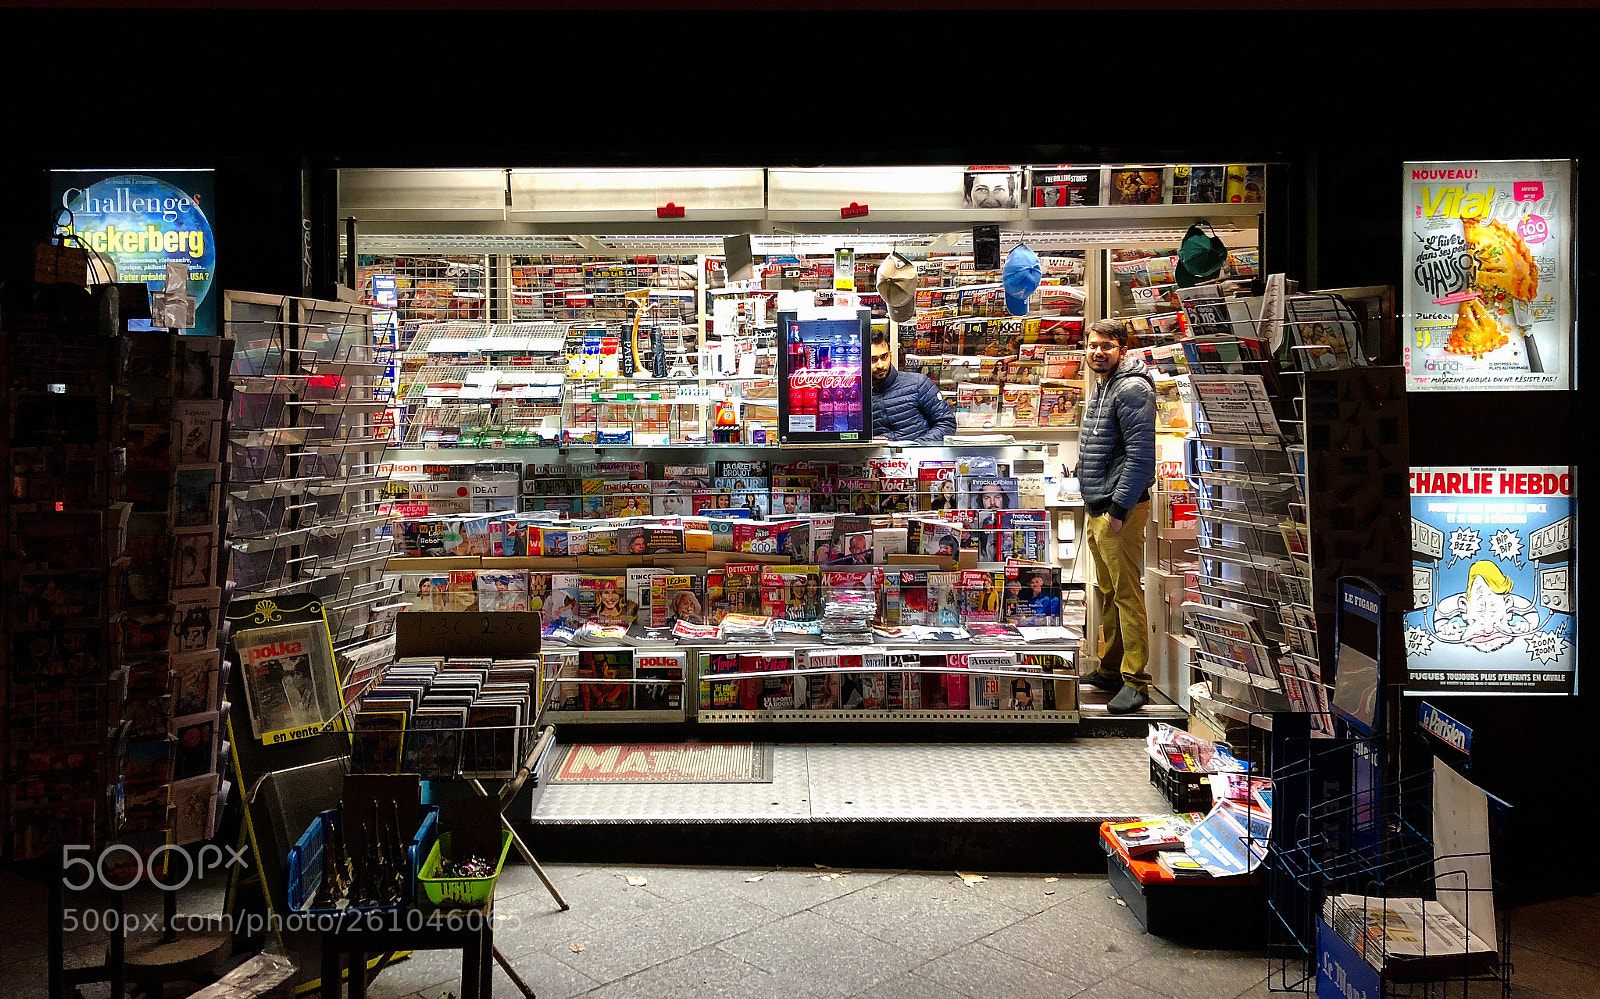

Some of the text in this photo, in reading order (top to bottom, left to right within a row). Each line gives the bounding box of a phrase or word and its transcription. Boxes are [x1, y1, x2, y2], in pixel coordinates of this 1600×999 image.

[1421, 186, 1495, 219] Vital
[1519, 221, 1546, 236] 100
[119, 273, 140, 281] Futur
[623, 340, 633, 374] PARIS
[869, 460, 908, 470] Society
[881, 479, 905, 491] Voici
[1500, 473, 1575, 495] HEBDO
[1457, 533, 1476, 542] BZZ
[751, 543, 771, 552] 300
[1454, 542, 1474, 551] BZZ
[1344, 592, 1379, 614] LE FIGARO
[1410, 632, 1425, 640] TUT
[1533, 638, 1556, 647] ZOOM
[249, 640, 302, 660] polka
[1535, 646, 1556, 656] ZOOM
[640, 657, 678, 668] polka
[1481, 673, 1496, 681] PLUS
[273, 731, 288, 742] en
[289, 725, 319, 739] vente
[1430, 711, 1467, 749] Parisien
